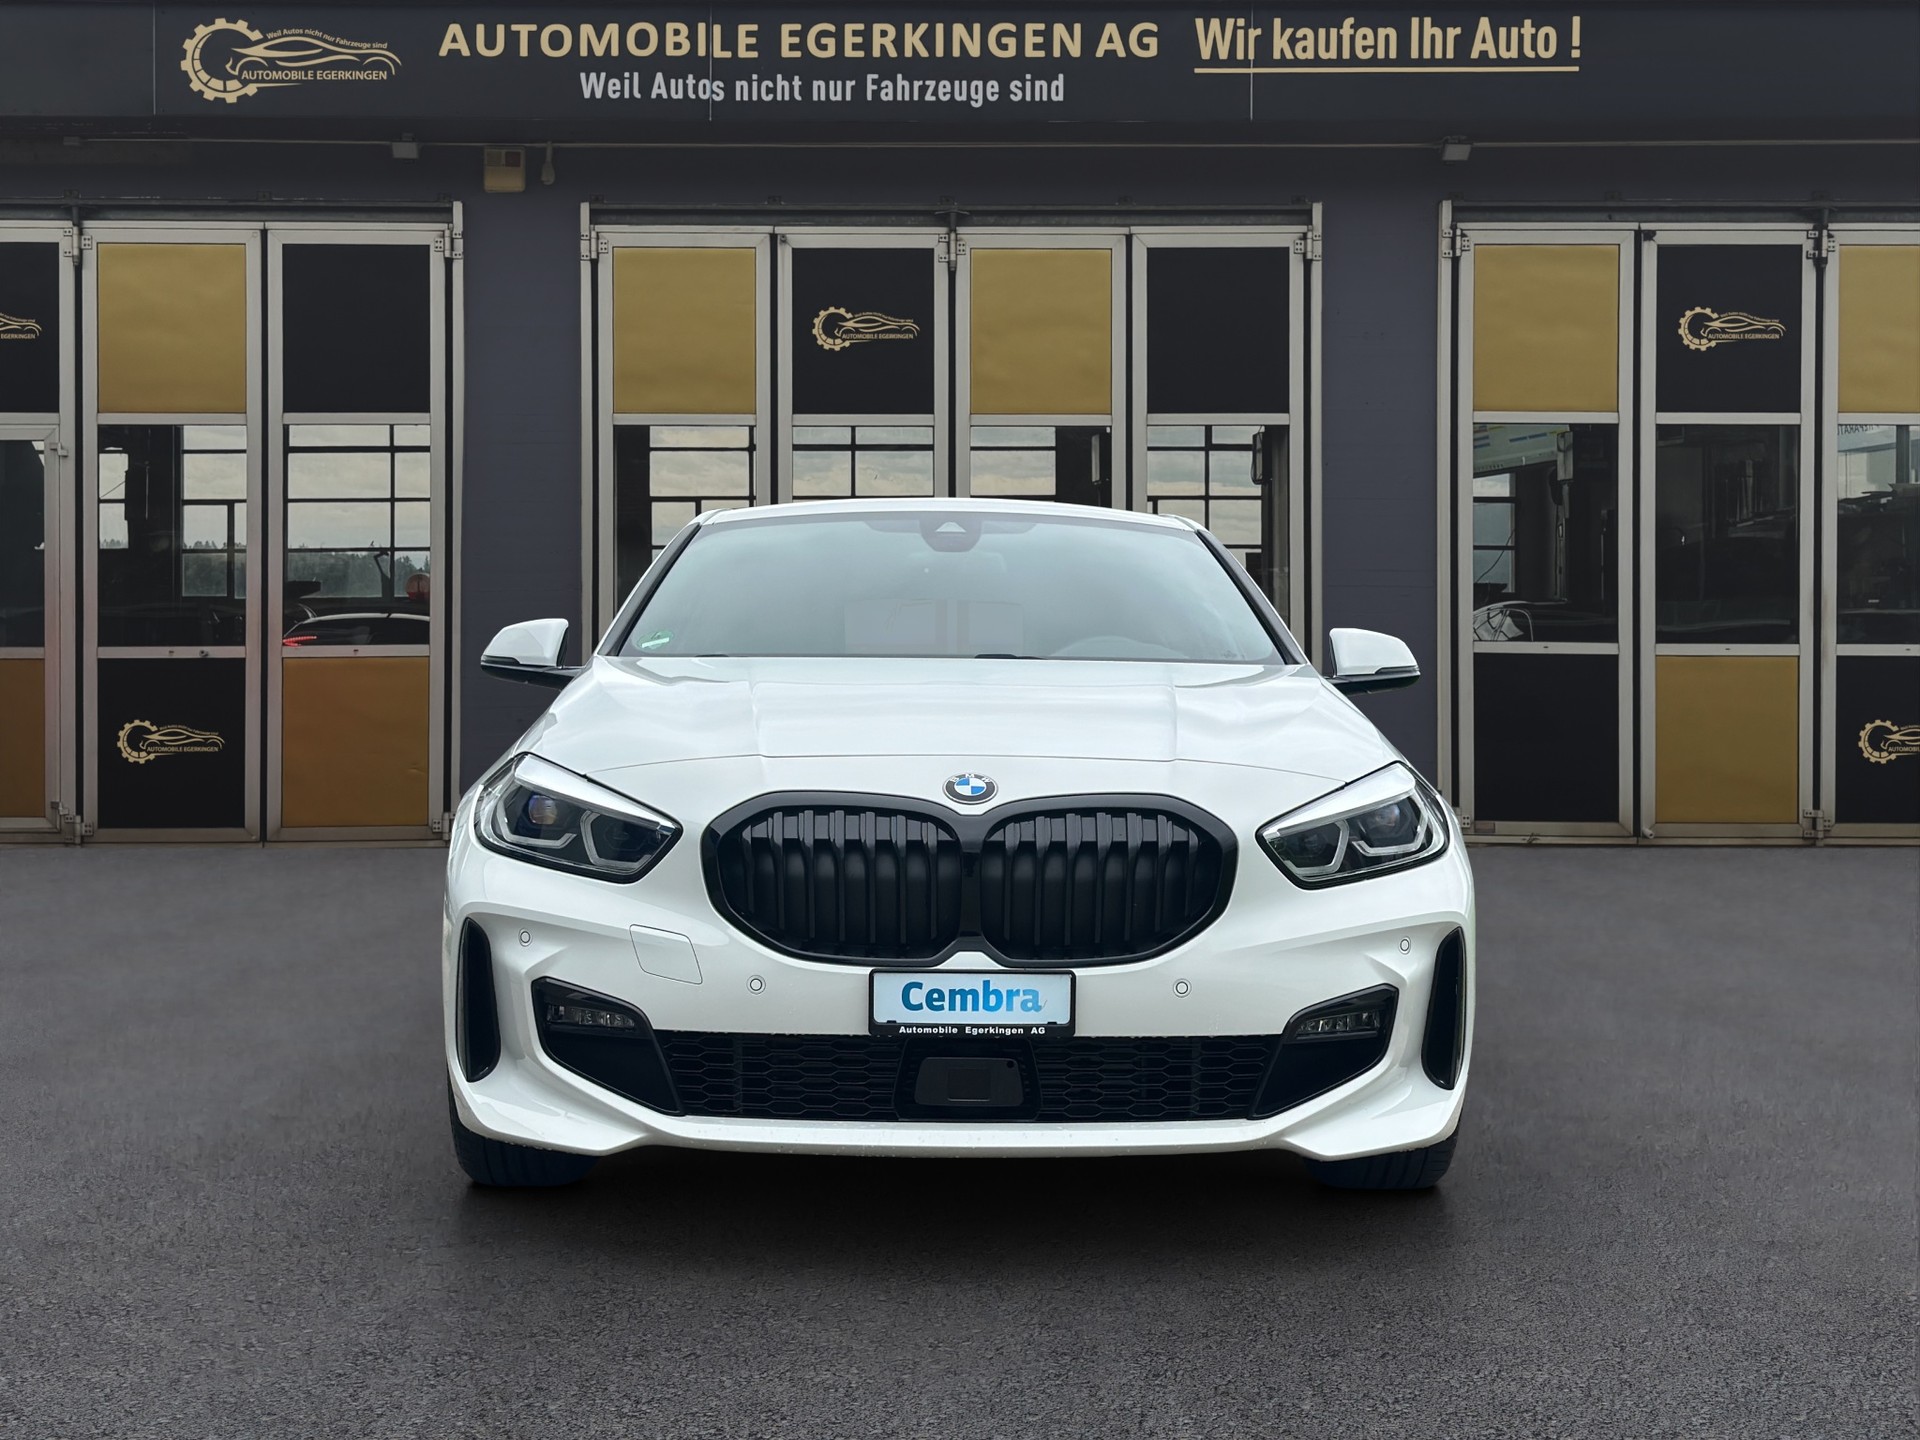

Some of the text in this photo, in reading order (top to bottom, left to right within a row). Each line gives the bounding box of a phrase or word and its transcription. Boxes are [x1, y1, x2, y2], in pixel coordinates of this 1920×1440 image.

[266, 29, 281, 39] Weil
[283, 28, 303, 36] Autos
[304, 28, 323, 38] nicht
[323, 33, 335, 42] nur
[335, 37, 371, 49] Fahrzeuge
[438, 22, 1159, 58] AUTOMOBILE EGERKINGEN AG
[1194, 15, 1581, 60] Wir kaufen Ihr Auto !
[241, 70, 387, 80] AUTOMOBILE EGERKINGEN
[580, 71, 1064, 108] Weil Autos nicht nur Fahrzeuge sind
[901, 979, 1042, 1013] Cembra
[899, 1026, 1046, 1035] Automobile Egerkingen AG
